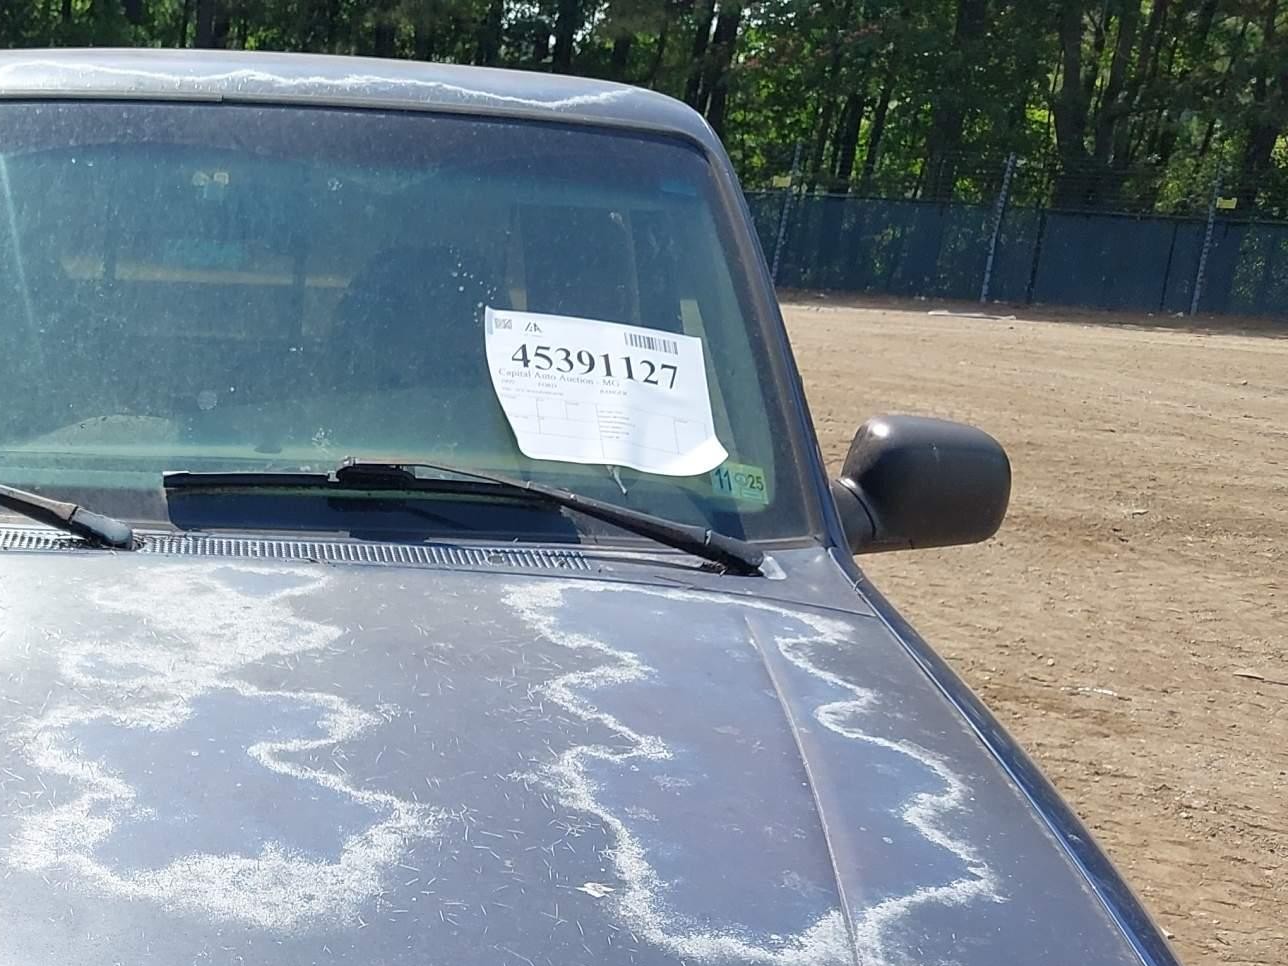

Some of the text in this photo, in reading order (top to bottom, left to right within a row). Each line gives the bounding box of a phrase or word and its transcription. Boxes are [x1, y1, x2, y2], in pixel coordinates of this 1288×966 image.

[498, 367, 531, 380] Capital
[534, 371, 557, 381] Auto
[559, 374, 594, 386] Auction
[511, 343, 678, 389] 45391127
[715, 468, 764, 492] 11 25
